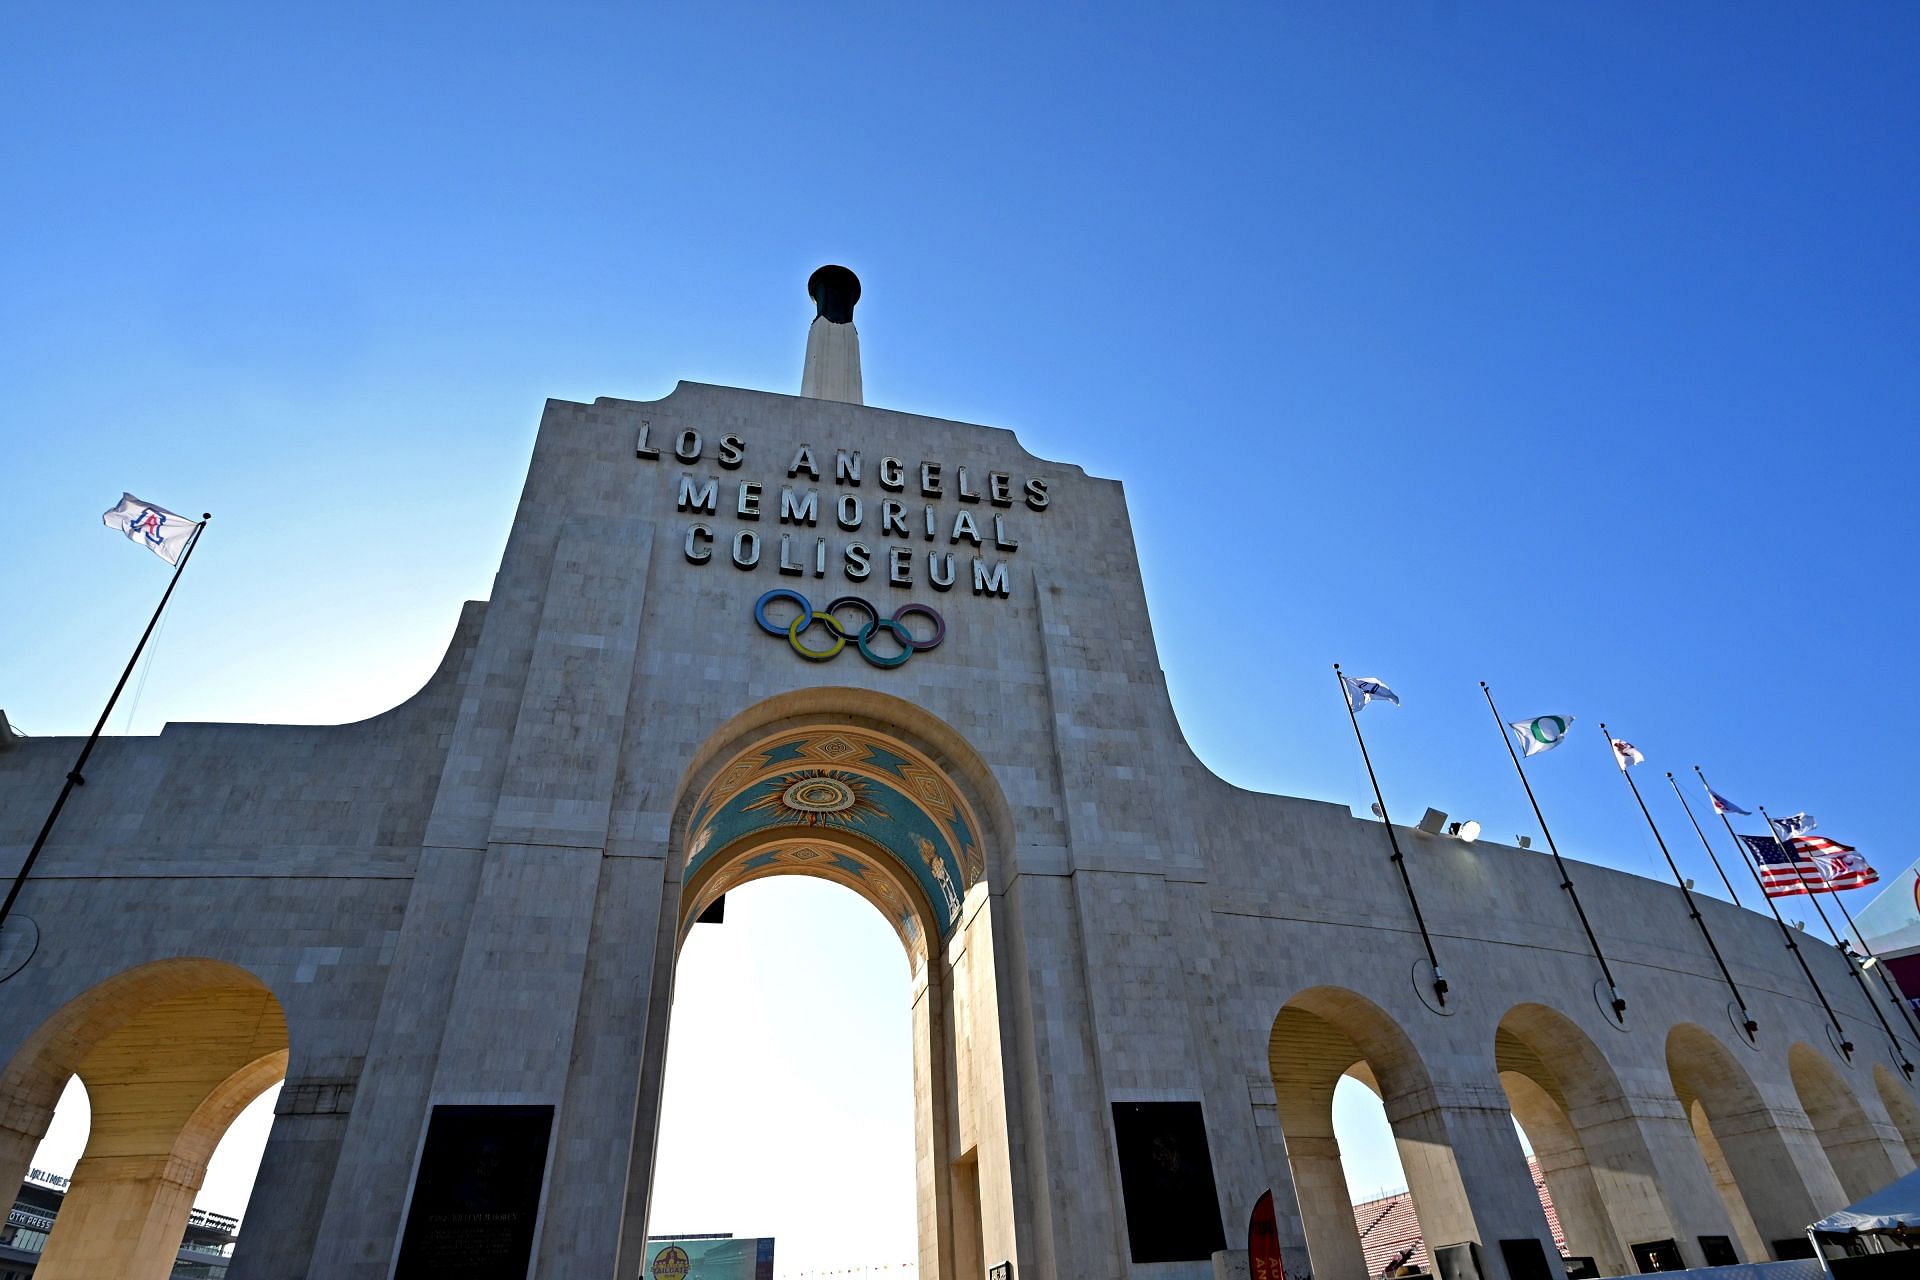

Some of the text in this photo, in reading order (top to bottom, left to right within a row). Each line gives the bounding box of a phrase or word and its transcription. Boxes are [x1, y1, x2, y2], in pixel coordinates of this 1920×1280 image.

[636, 420, 1051, 512] LOS ANGELES
[131, 507, 166, 545] A
[677, 472, 1018, 553] MEMORIAL
[684, 523, 1010, 600] COLISEUM
[26, 1168, 69, 1187] IRLINES
[27, 1217, 51, 1229] PRESS
